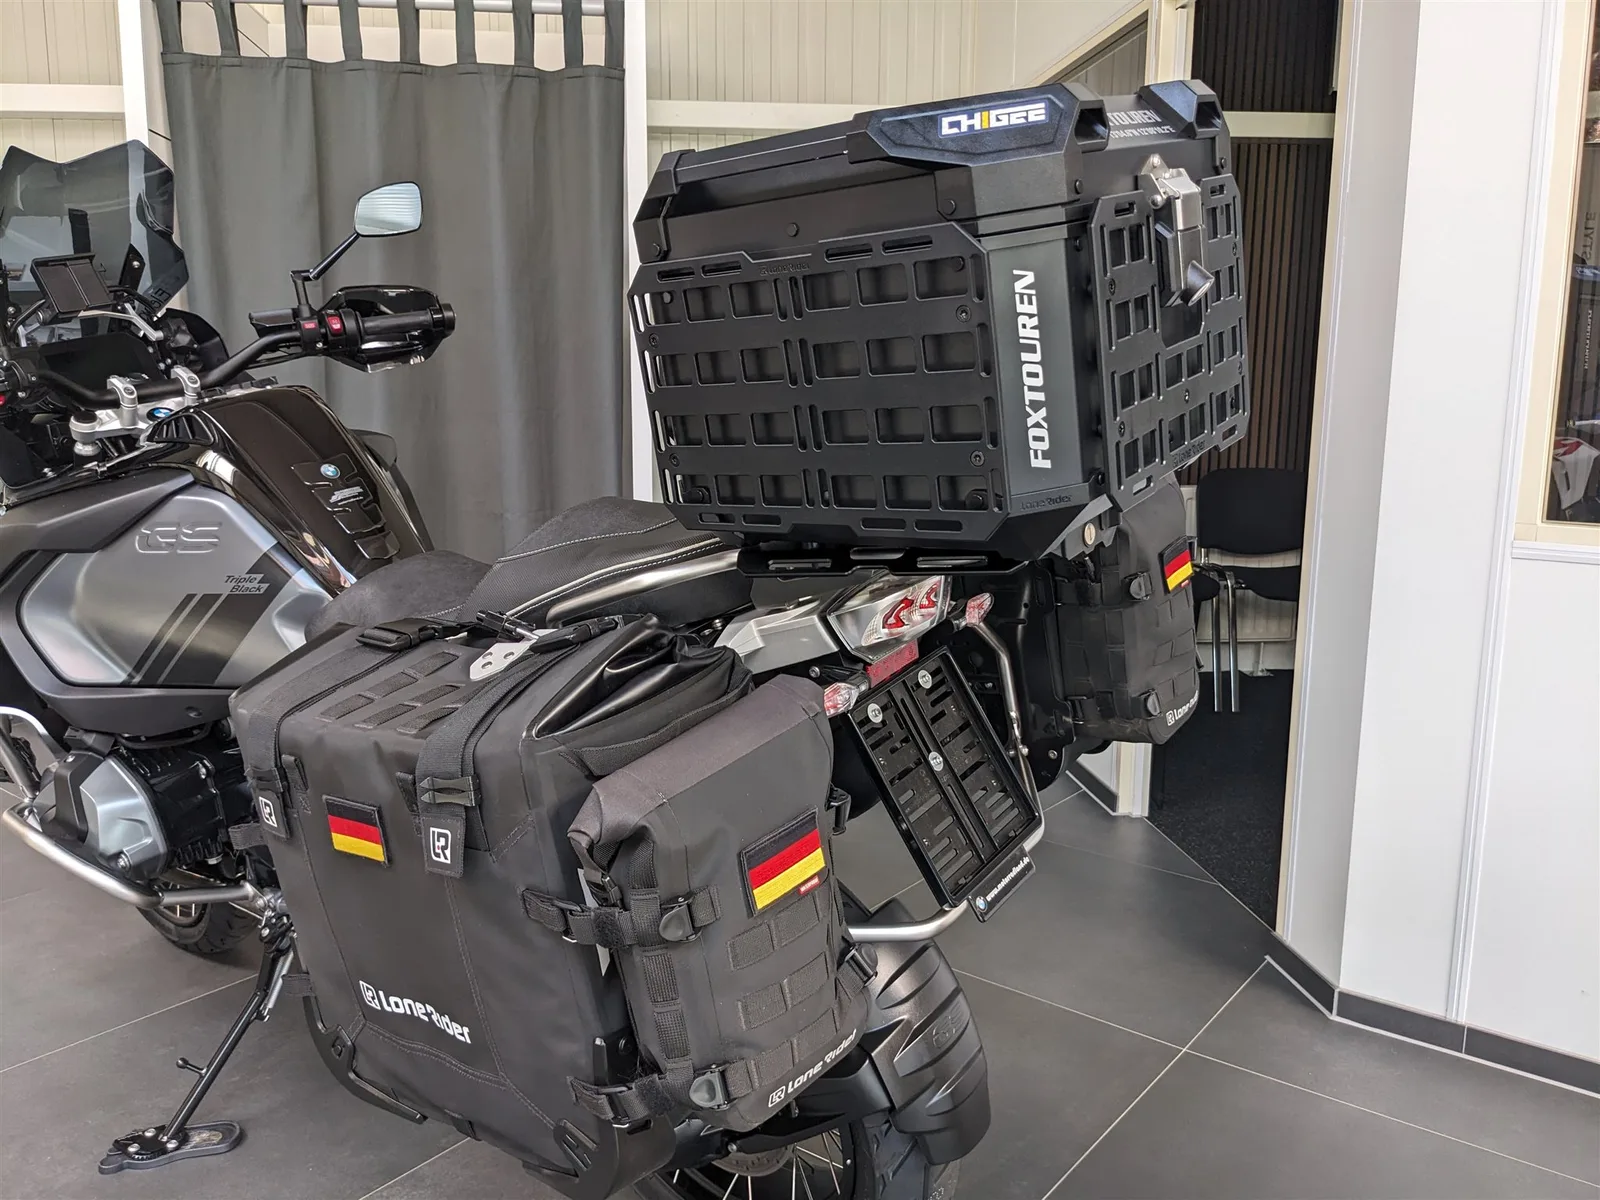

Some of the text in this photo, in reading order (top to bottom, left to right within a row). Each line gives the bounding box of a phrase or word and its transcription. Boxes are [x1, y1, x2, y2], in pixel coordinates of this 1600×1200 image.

[941, 102, 1046, 136] CHIGEE
[1012, 269, 1052, 469] FOXTOUREN
[135, 521, 223, 554] GS
[224, 575, 258, 585] Triple
[229, 584, 264, 593] Black
